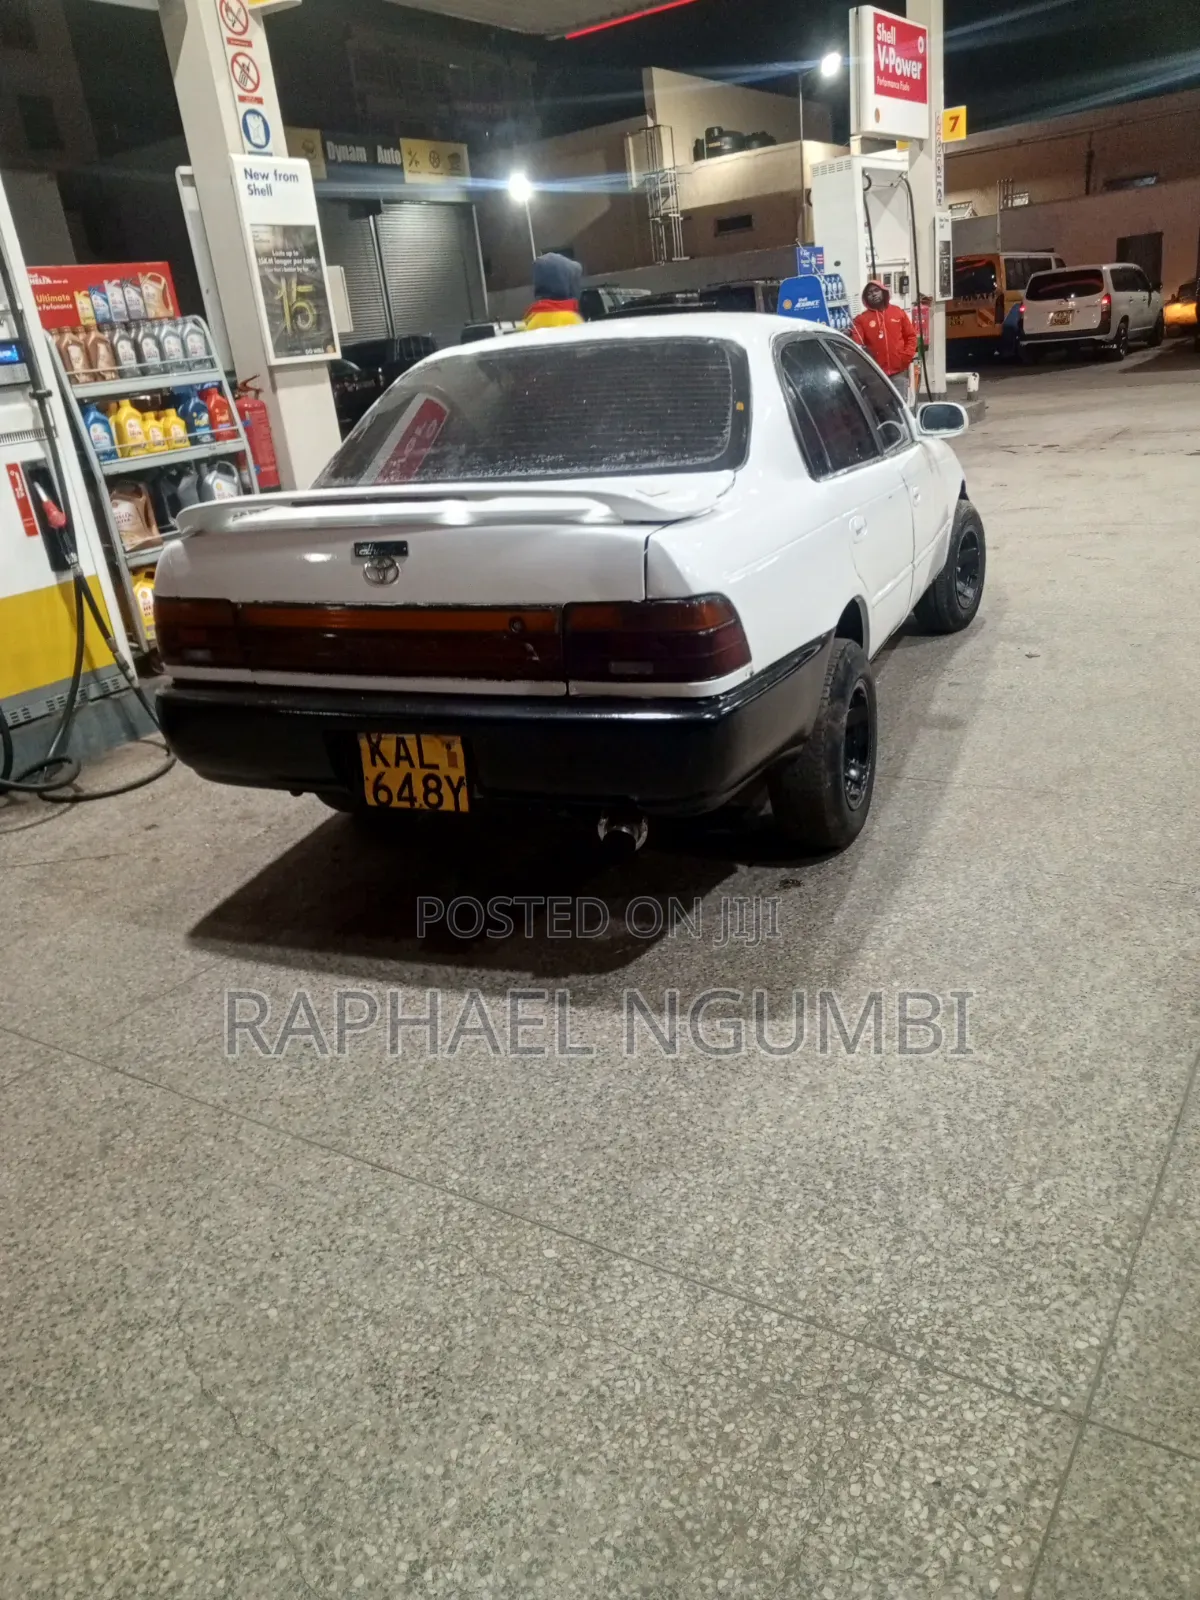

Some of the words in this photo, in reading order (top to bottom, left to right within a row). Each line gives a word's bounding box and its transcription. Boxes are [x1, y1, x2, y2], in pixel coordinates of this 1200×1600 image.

[876, 23, 896, 46] Shell
[877, 43, 922, 80] V-Power
[949, 114, 960, 133] 7
[377, 145, 402, 165] Auto
[244, 167, 269, 181] New
[273, 168, 299, 183] from
[247, 182, 273, 197] Shell
[36, 294, 71, 304] Ultimate
[366, 733, 440, 770] KAL
[372, 771, 465, 811] 648Y
